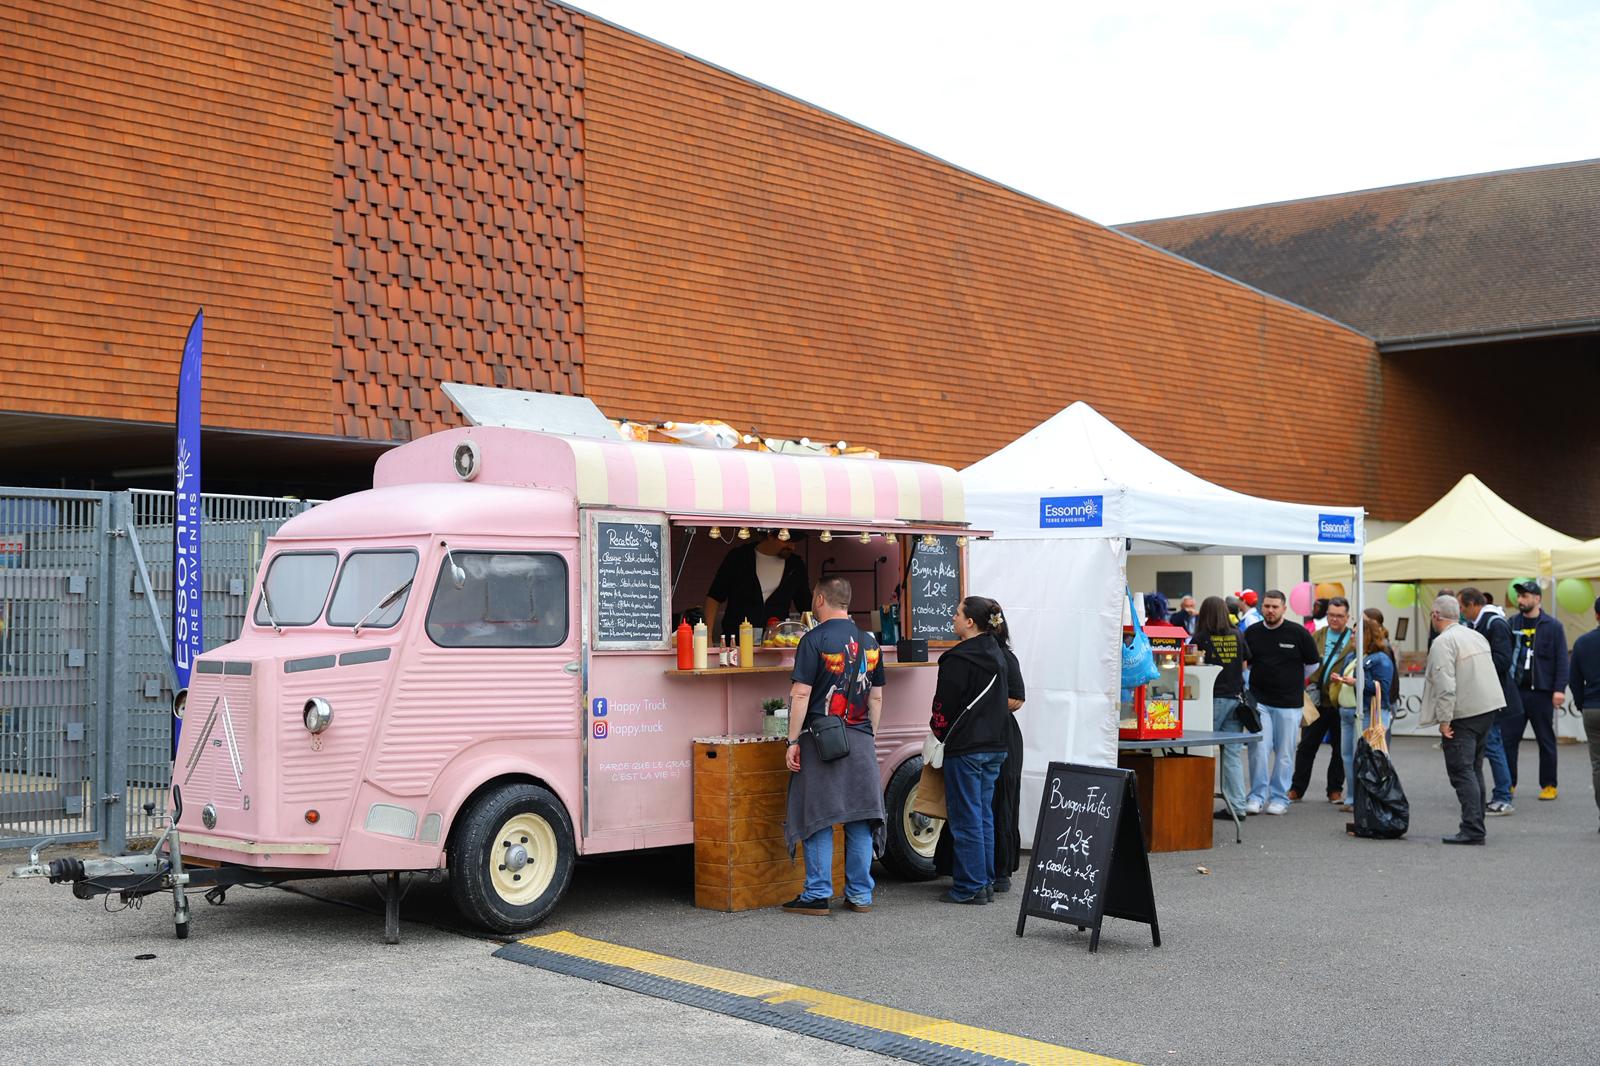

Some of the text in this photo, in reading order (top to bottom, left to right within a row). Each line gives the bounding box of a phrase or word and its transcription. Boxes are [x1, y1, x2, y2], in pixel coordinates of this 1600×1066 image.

[1045, 504, 1093, 517] Essonne
[1321, 520, 1349, 533] Essonne
[189, 493, 199, 658] ERRE D'AVENIRS
[923, 580, 947, 597] 12€
[609, 698, 668, 715] Happy Truck
[609, 720, 664, 737] happy.truck
[631, 761, 650, 770] QUE
[1056, 826, 1093, 856] 12€
